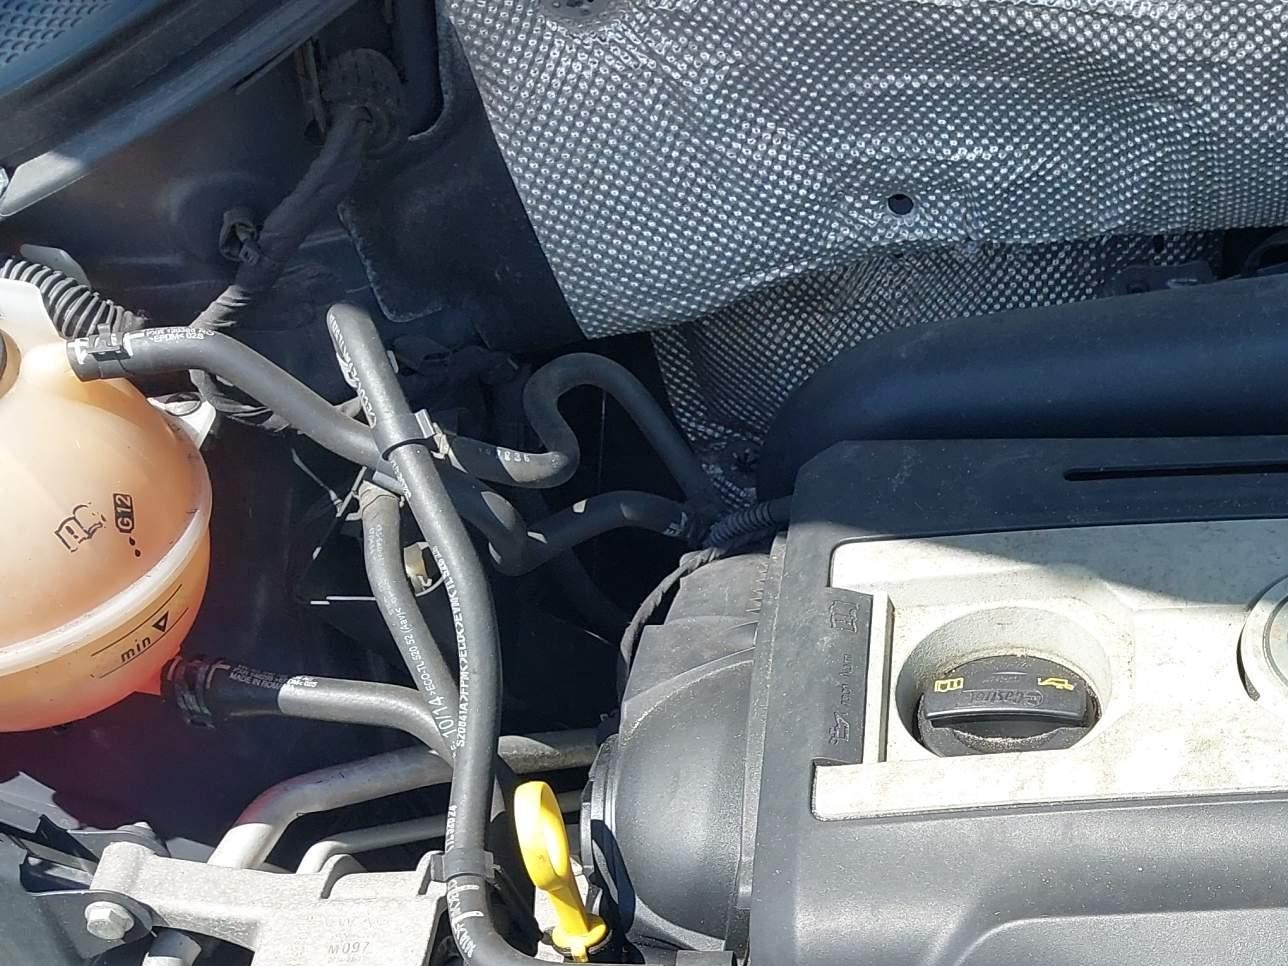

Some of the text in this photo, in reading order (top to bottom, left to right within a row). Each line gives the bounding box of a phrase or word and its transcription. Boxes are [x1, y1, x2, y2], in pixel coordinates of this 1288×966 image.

[115, 494, 133, 531] G12
[121, 636, 151, 662] min
[429, 695, 457, 738] 10/14
